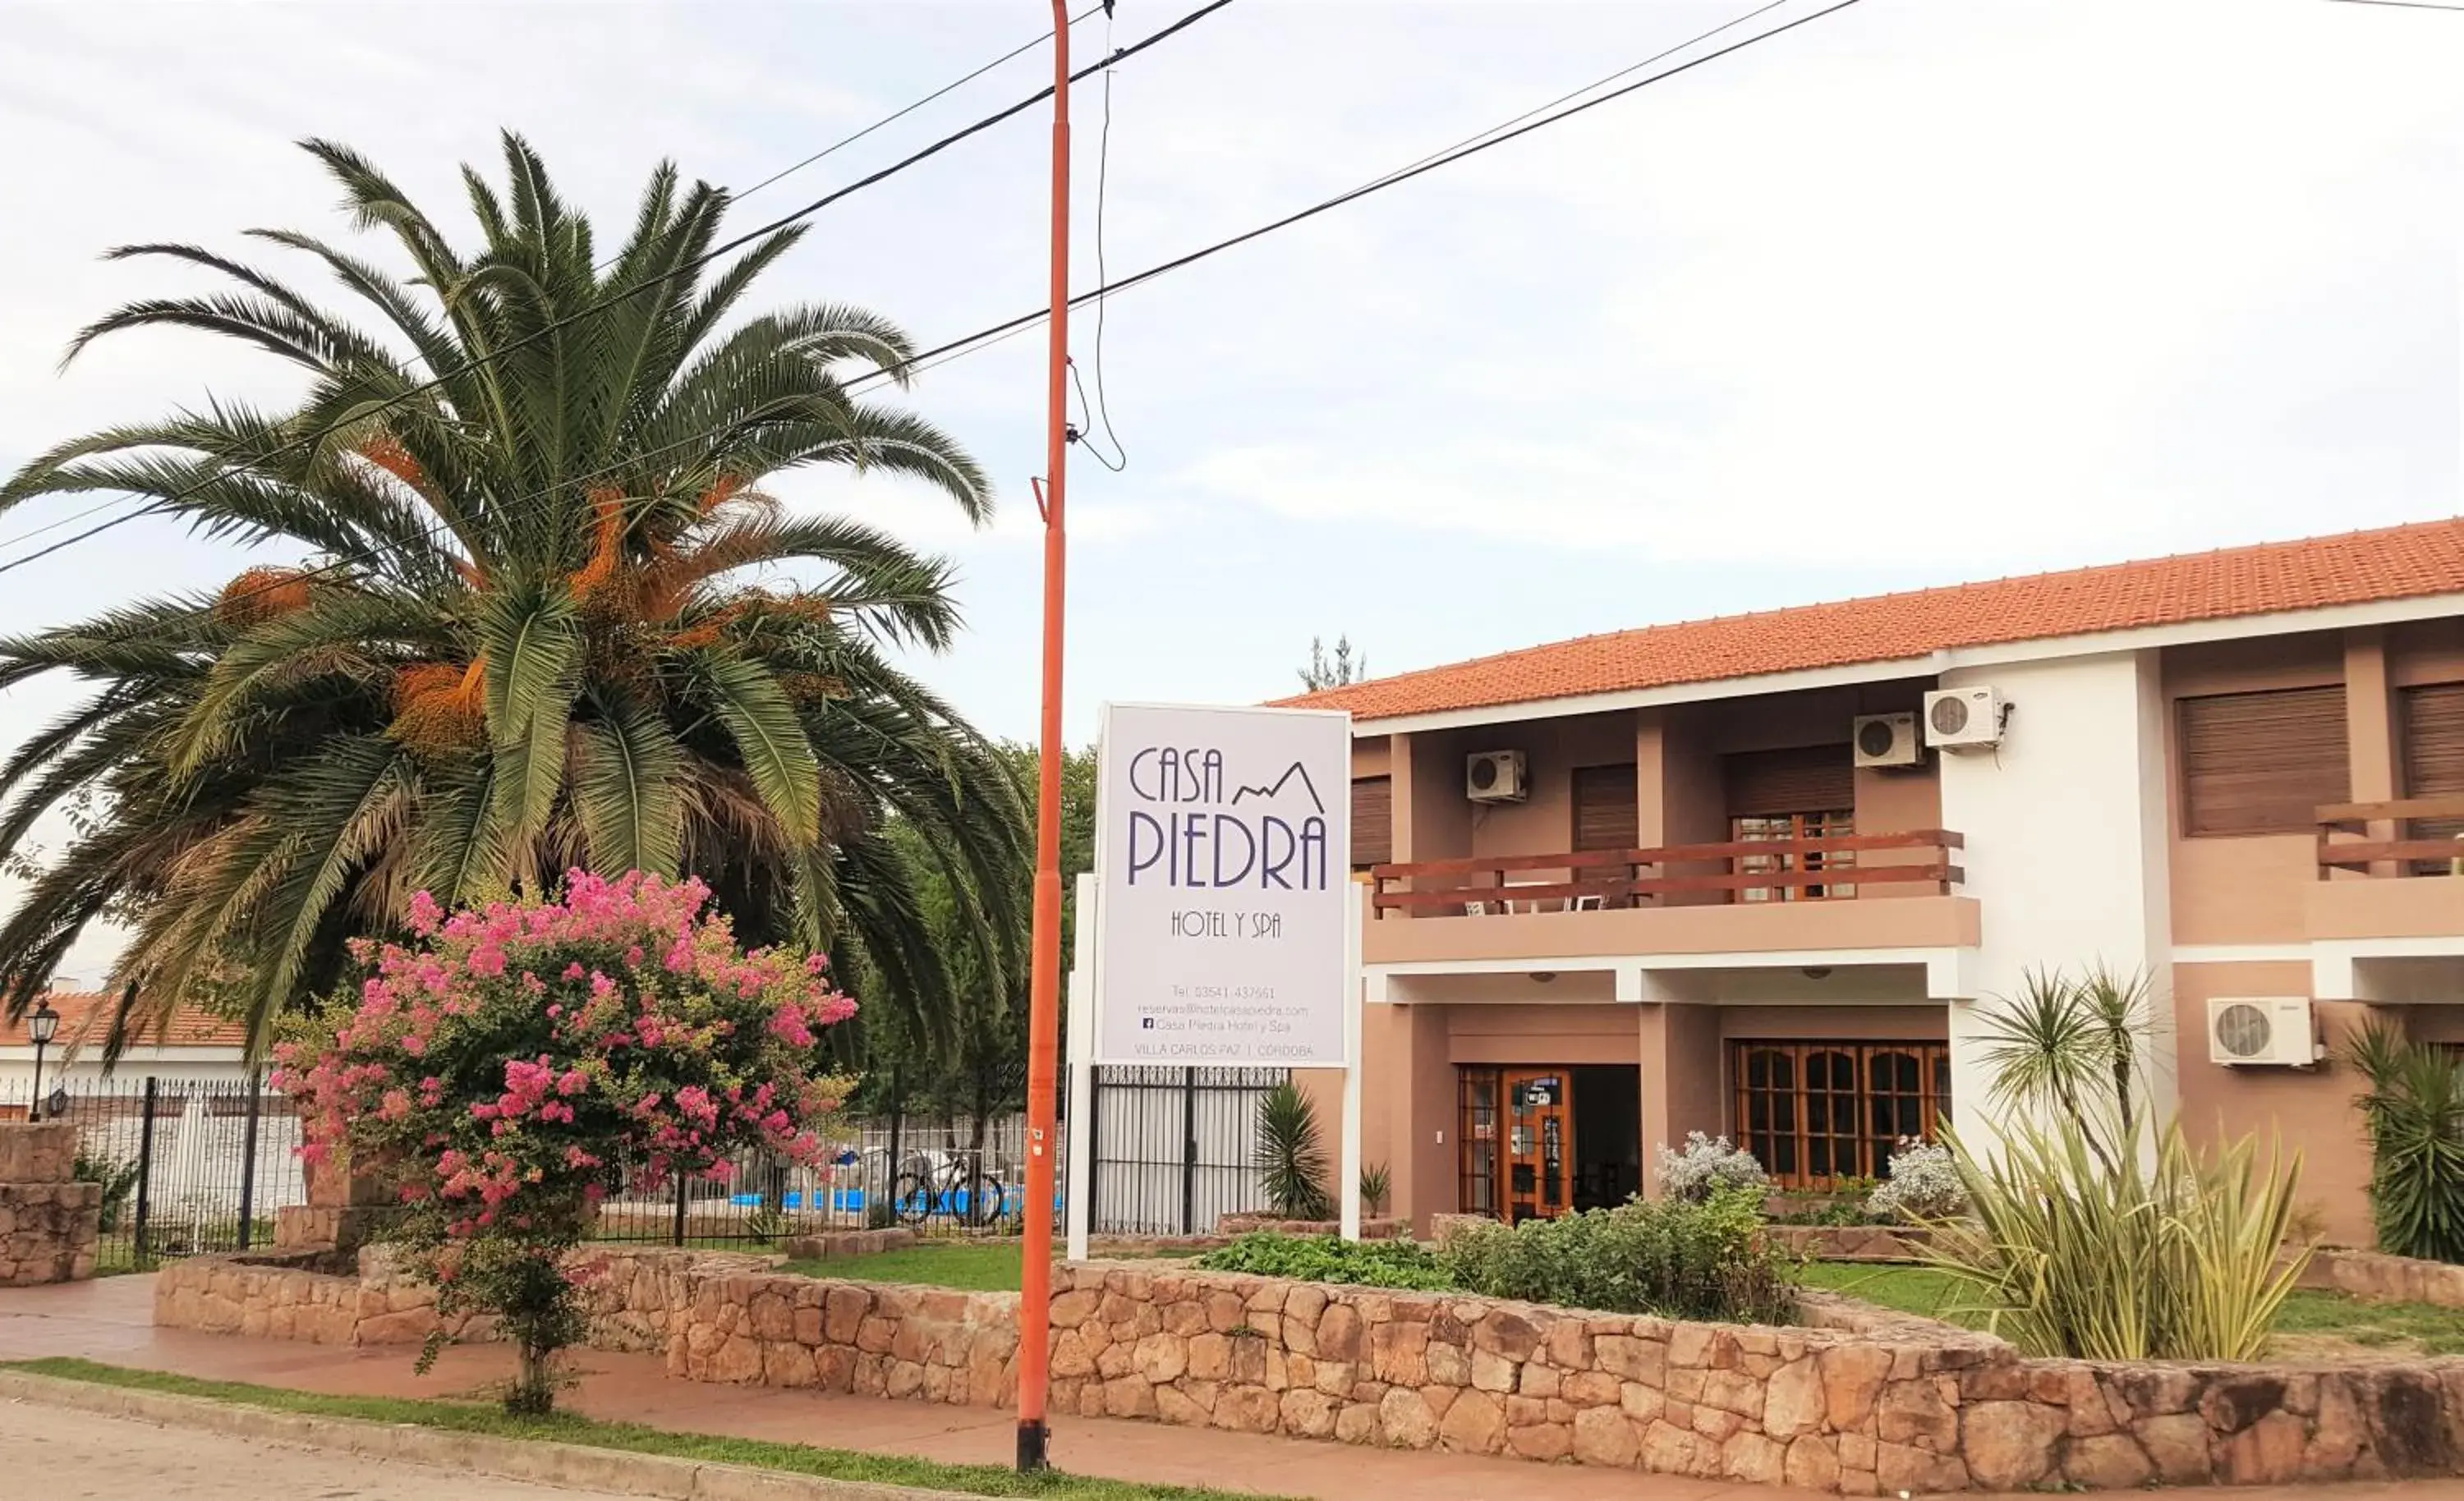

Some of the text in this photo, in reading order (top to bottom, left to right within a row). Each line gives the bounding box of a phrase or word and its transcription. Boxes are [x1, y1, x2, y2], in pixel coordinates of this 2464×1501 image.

[1129, 746, 1222, 804] CASA
[1129, 810, 1326, 891] PIEDRA
[1171, 911, 1280, 939] HOTEL Y SPA
[1156, 1018, 1185, 1030] Casa
[1188, 1018, 1225, 1031] Piedra
[1228, 1019, 1257, 1031] Hotel
[1269, 1020, 1291, 1034] Spa
[1133, 1043, 1167, 1055] VILLA
[1170, 1043, 1216, 1056] CARLOS
[1219, 1044, 1241, 1056] PAZ
